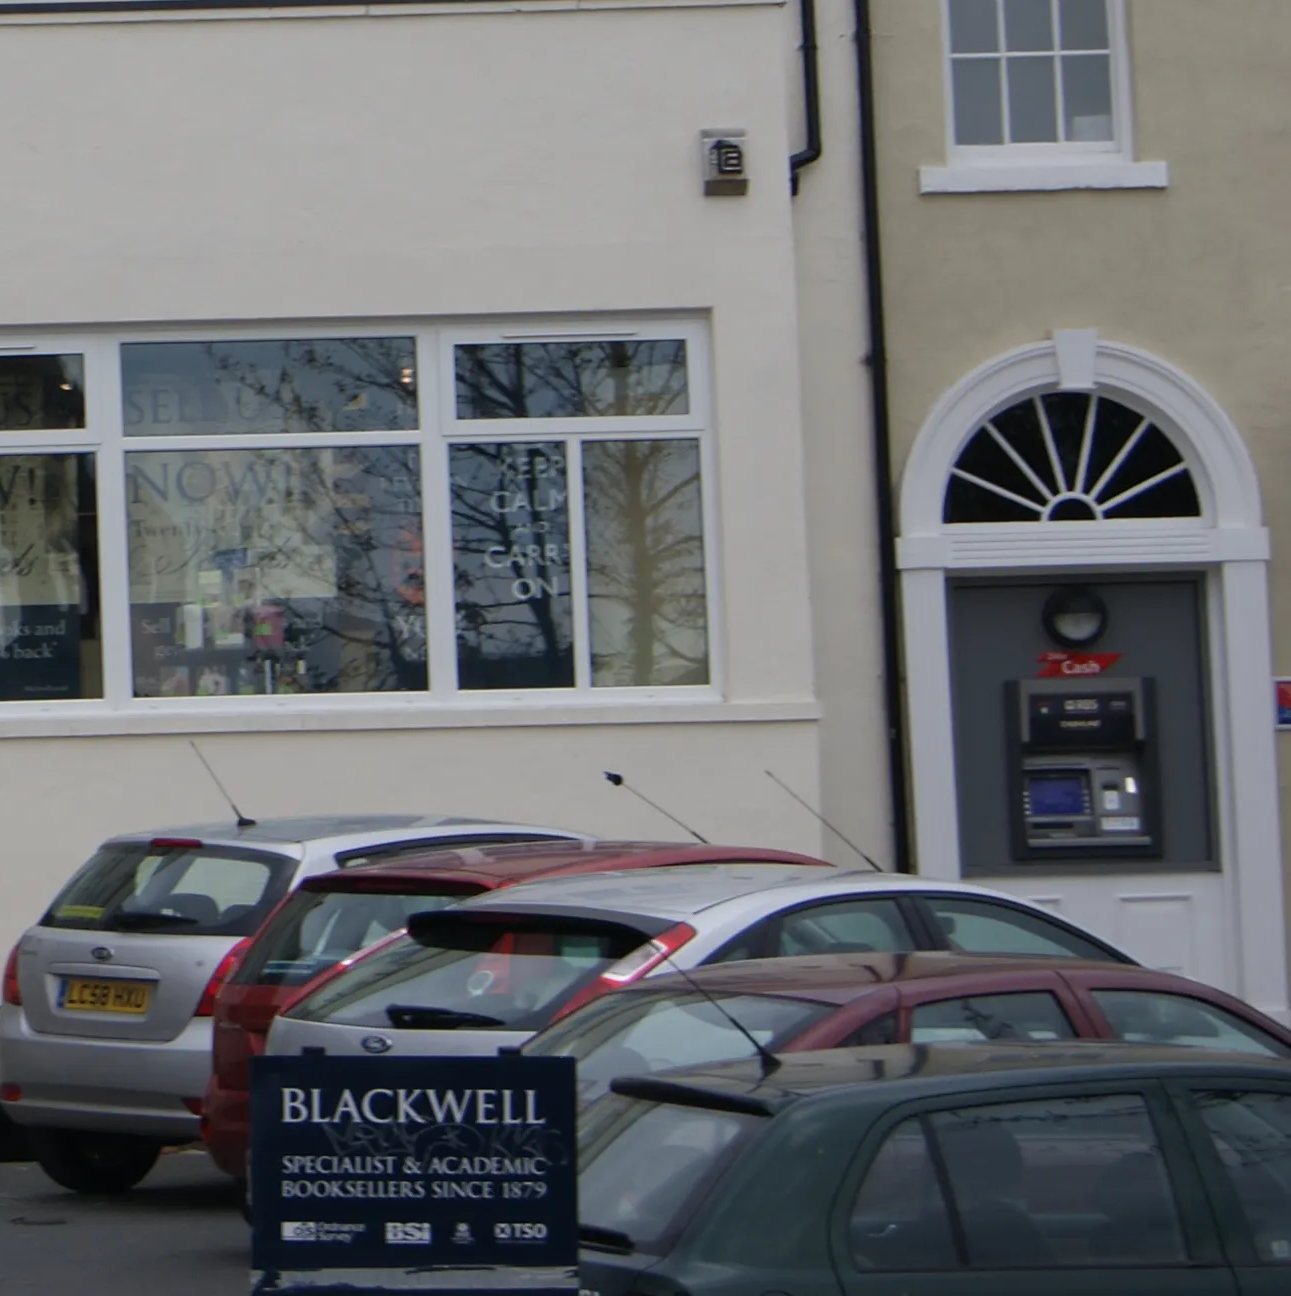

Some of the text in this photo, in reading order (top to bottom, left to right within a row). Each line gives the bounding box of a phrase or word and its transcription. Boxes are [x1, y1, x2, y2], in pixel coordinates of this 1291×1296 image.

[490, 489, 566, 512] CALM
[483, 544, 571, 568] CARR
[511, 577, 558, 599] ON
[33, 619, 66, 637] and
[1061, 659, 1101, 674] Cash
[280, 1087, 547, 1124] BLACKWELL
[281, 1156, 547, 1175] SPECIALIST & ACADEMIC
[281, 1181, 548, 1199] BOOKSELLERS SINCE 1879
[512, 1222, 548, 1239] TSO
